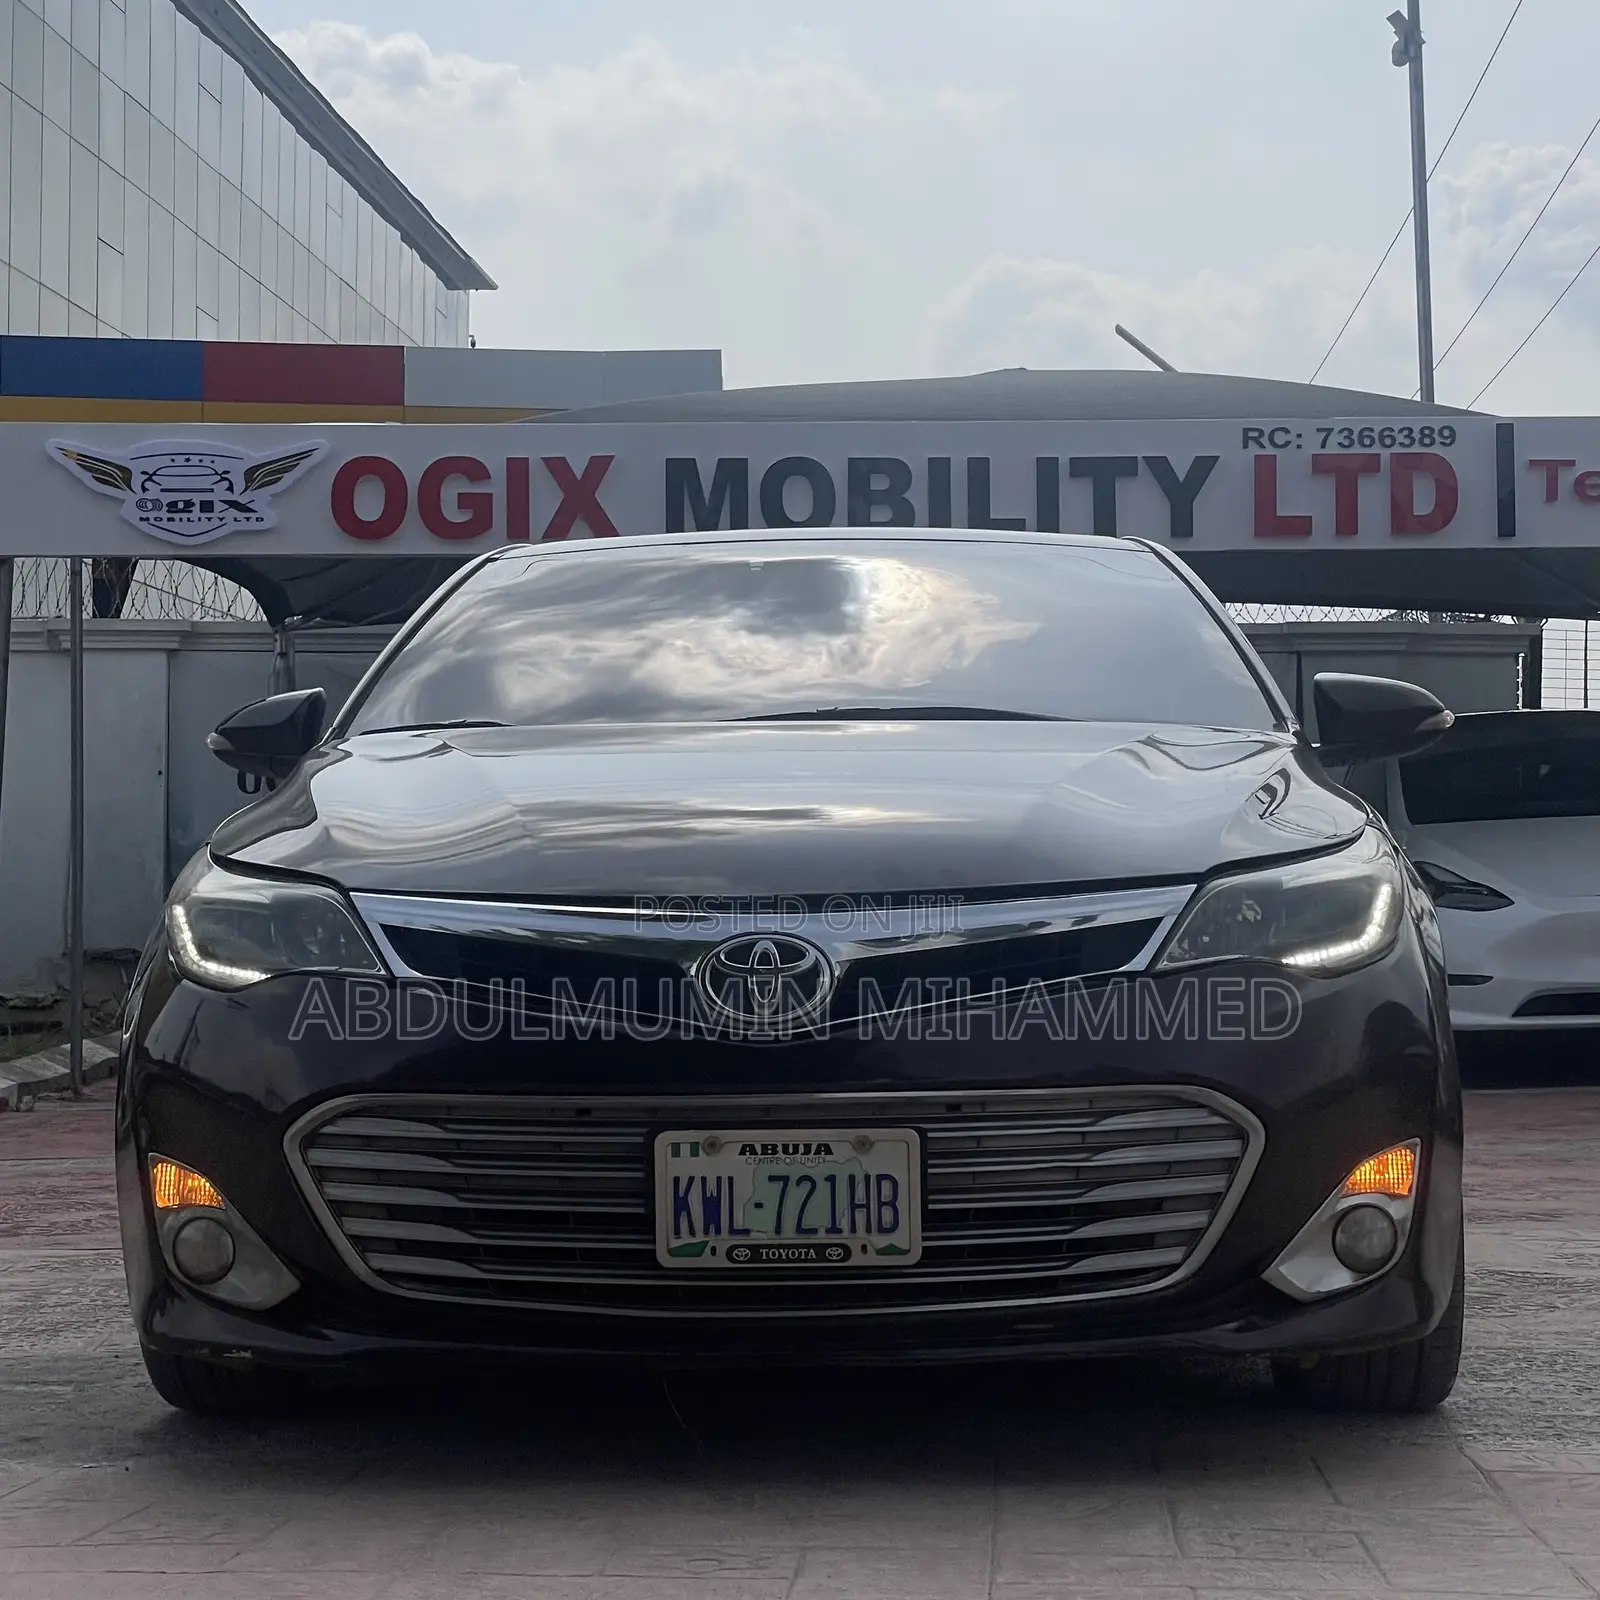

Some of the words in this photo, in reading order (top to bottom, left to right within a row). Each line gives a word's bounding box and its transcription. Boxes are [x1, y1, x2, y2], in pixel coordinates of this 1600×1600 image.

[1242, 427, 1303, 449] RC:
[1316, 425, 1457, 449] 7366389
[331, 455, 620, 540] OGIX
[665, 455, 1220, 538] MOBILITY
[1254, 452, 1459, 537] LTD
[738, 1143, 834, 1156] ABUJA
[745, 1156, 781, 1166] CENTRE
[783, 1156, 797, 1167] OF
[800, 1156, 828, 1166] UNITY
[759, 1248, 817, 1260] TOYOTA
